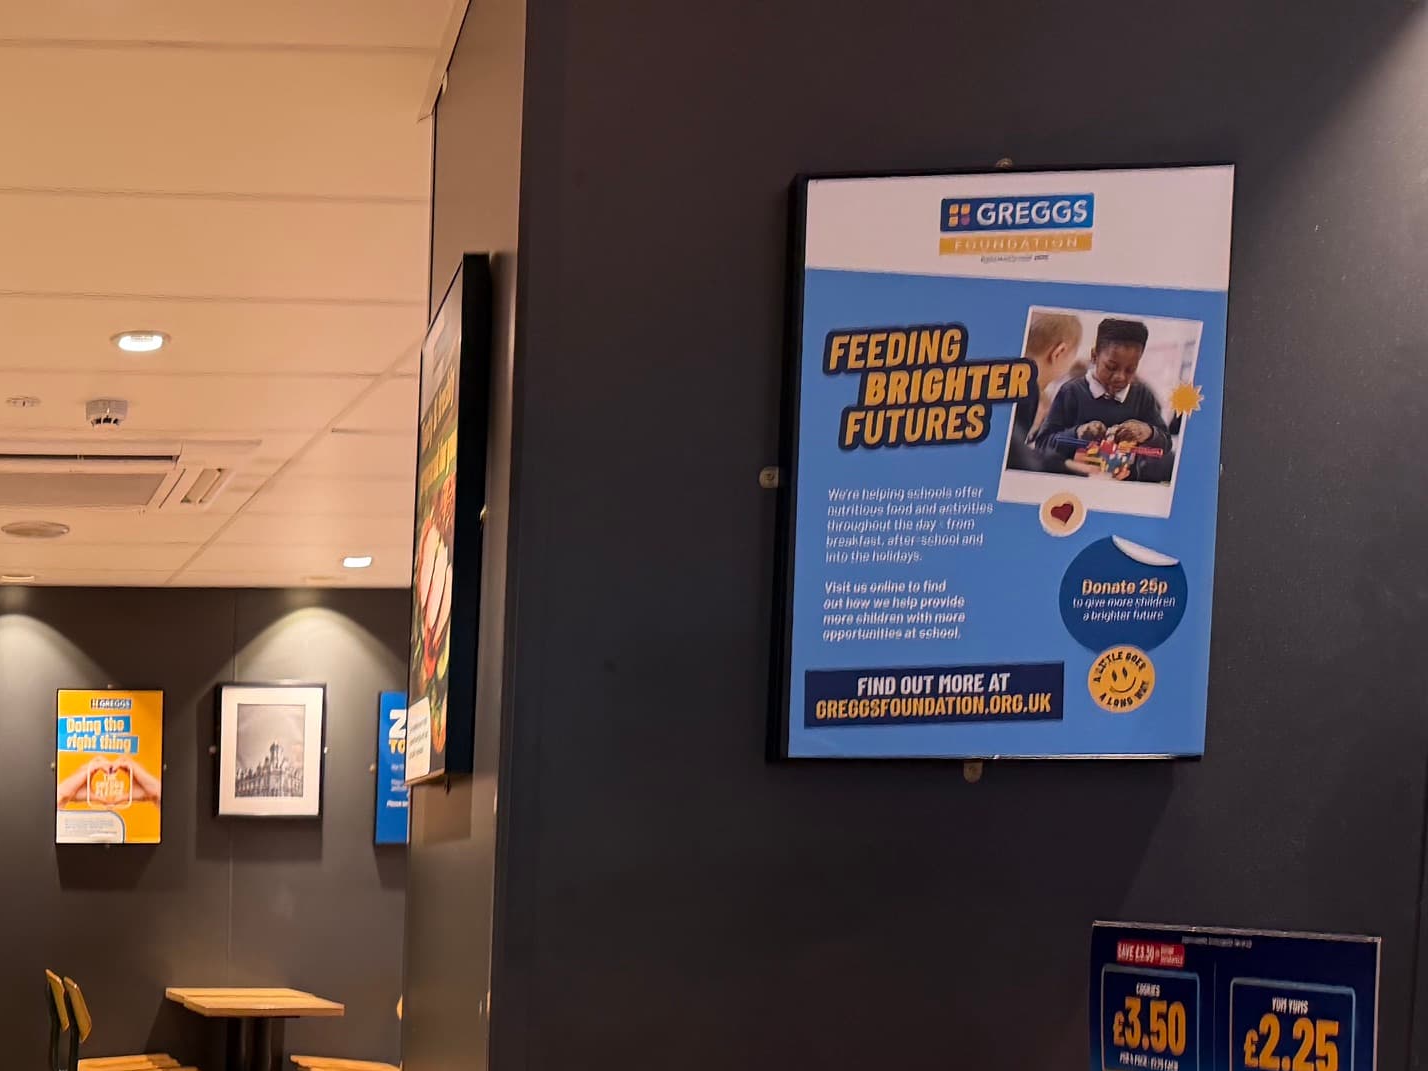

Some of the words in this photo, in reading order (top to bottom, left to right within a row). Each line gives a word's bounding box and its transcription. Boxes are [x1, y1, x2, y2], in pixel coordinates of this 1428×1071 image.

[976, 199, 1088, 226] GREGGS
[954, 238, 1078, 251] FOUNDATION
[828, 328, 963, 371] FEEDING
[863, 362, 1032, 407] BRIGHTER
[845, 404, 986, 447] FUTURES
[828, 487, 860, 501] We're
[862, 487, 905, 501] helping
[907, 486, 952, 500] schools
[954, 486, 984, 499] offer
[827, 503, 884, 516] nutritious
[887, 502, 913, 516] food
[915, 502, 937, 515] and
[939, 501, 994, 515] activities
[827, 518, 891, 533] throughout
[894, 518, 913, 531] the
[916, 518, 937, 533] day
[946, 518, 976, 531] from
[962, 533, 984, 546] and
[851, 550, 870, 563] the
[872, 550, 923, 564] holidays.
[825, 580, 851, 594] Visit
[853, 583, 867, 594] us
[870, 580, 906, 594] online
[908, 580, 920, 593] to
[923, 579, 947, 593] find
[1082, 578, 1136, 595] Donate
[1139, 577, 1168, 596] 25p
[823, 597, 844, 610] out
[846, 596, 871, 609] how
[873, 597, 890, 609] we
[892, 596, 918, 610] help
[920, 595, 966, 609] provide
[1073, 597, 1084, 609] to
[1085, 597, 1106, 609] give
[1107, 597, 1133, 608] more
[1135, 596, 1176, 609] children
[823, 613, 854, 625] more
[856, 611, 904, 625] children
[906, 611, 932, 624] with
[935, 611, 966, 624] more
[1083, 611, 1090, 621] a
[1091, 610, 1131, 623] brighter
[1133, 609, 1164, 621] future
[823, 628, 902, 642] opportunities
[905, 627, 917, 640] at
[919, 626, 961, 640] school.
[1125, 652, 1147, 673] GOES
[857, 676, 897, 697] FIND
[900, 675, 935, 696] OUT
[938, 673, 985, 694] MORE
[988, 672, 1011, 692] AT
[815, 692, 1052, 720] GREGGSFOUNDATION.ORG.UK
[1106, 696, 1134, 708] LONG
[66, 717, 102, 736] Doing
[104, 717, 124, 732] the
[66, 733, 97, 753] right
[100, 734, 131, 754] thing
[1272, 997, 1288, 1014] YUM
[1288, 998, 1309, 1015] YUMS
[1113, 996, 1186, 1056] £3.50
